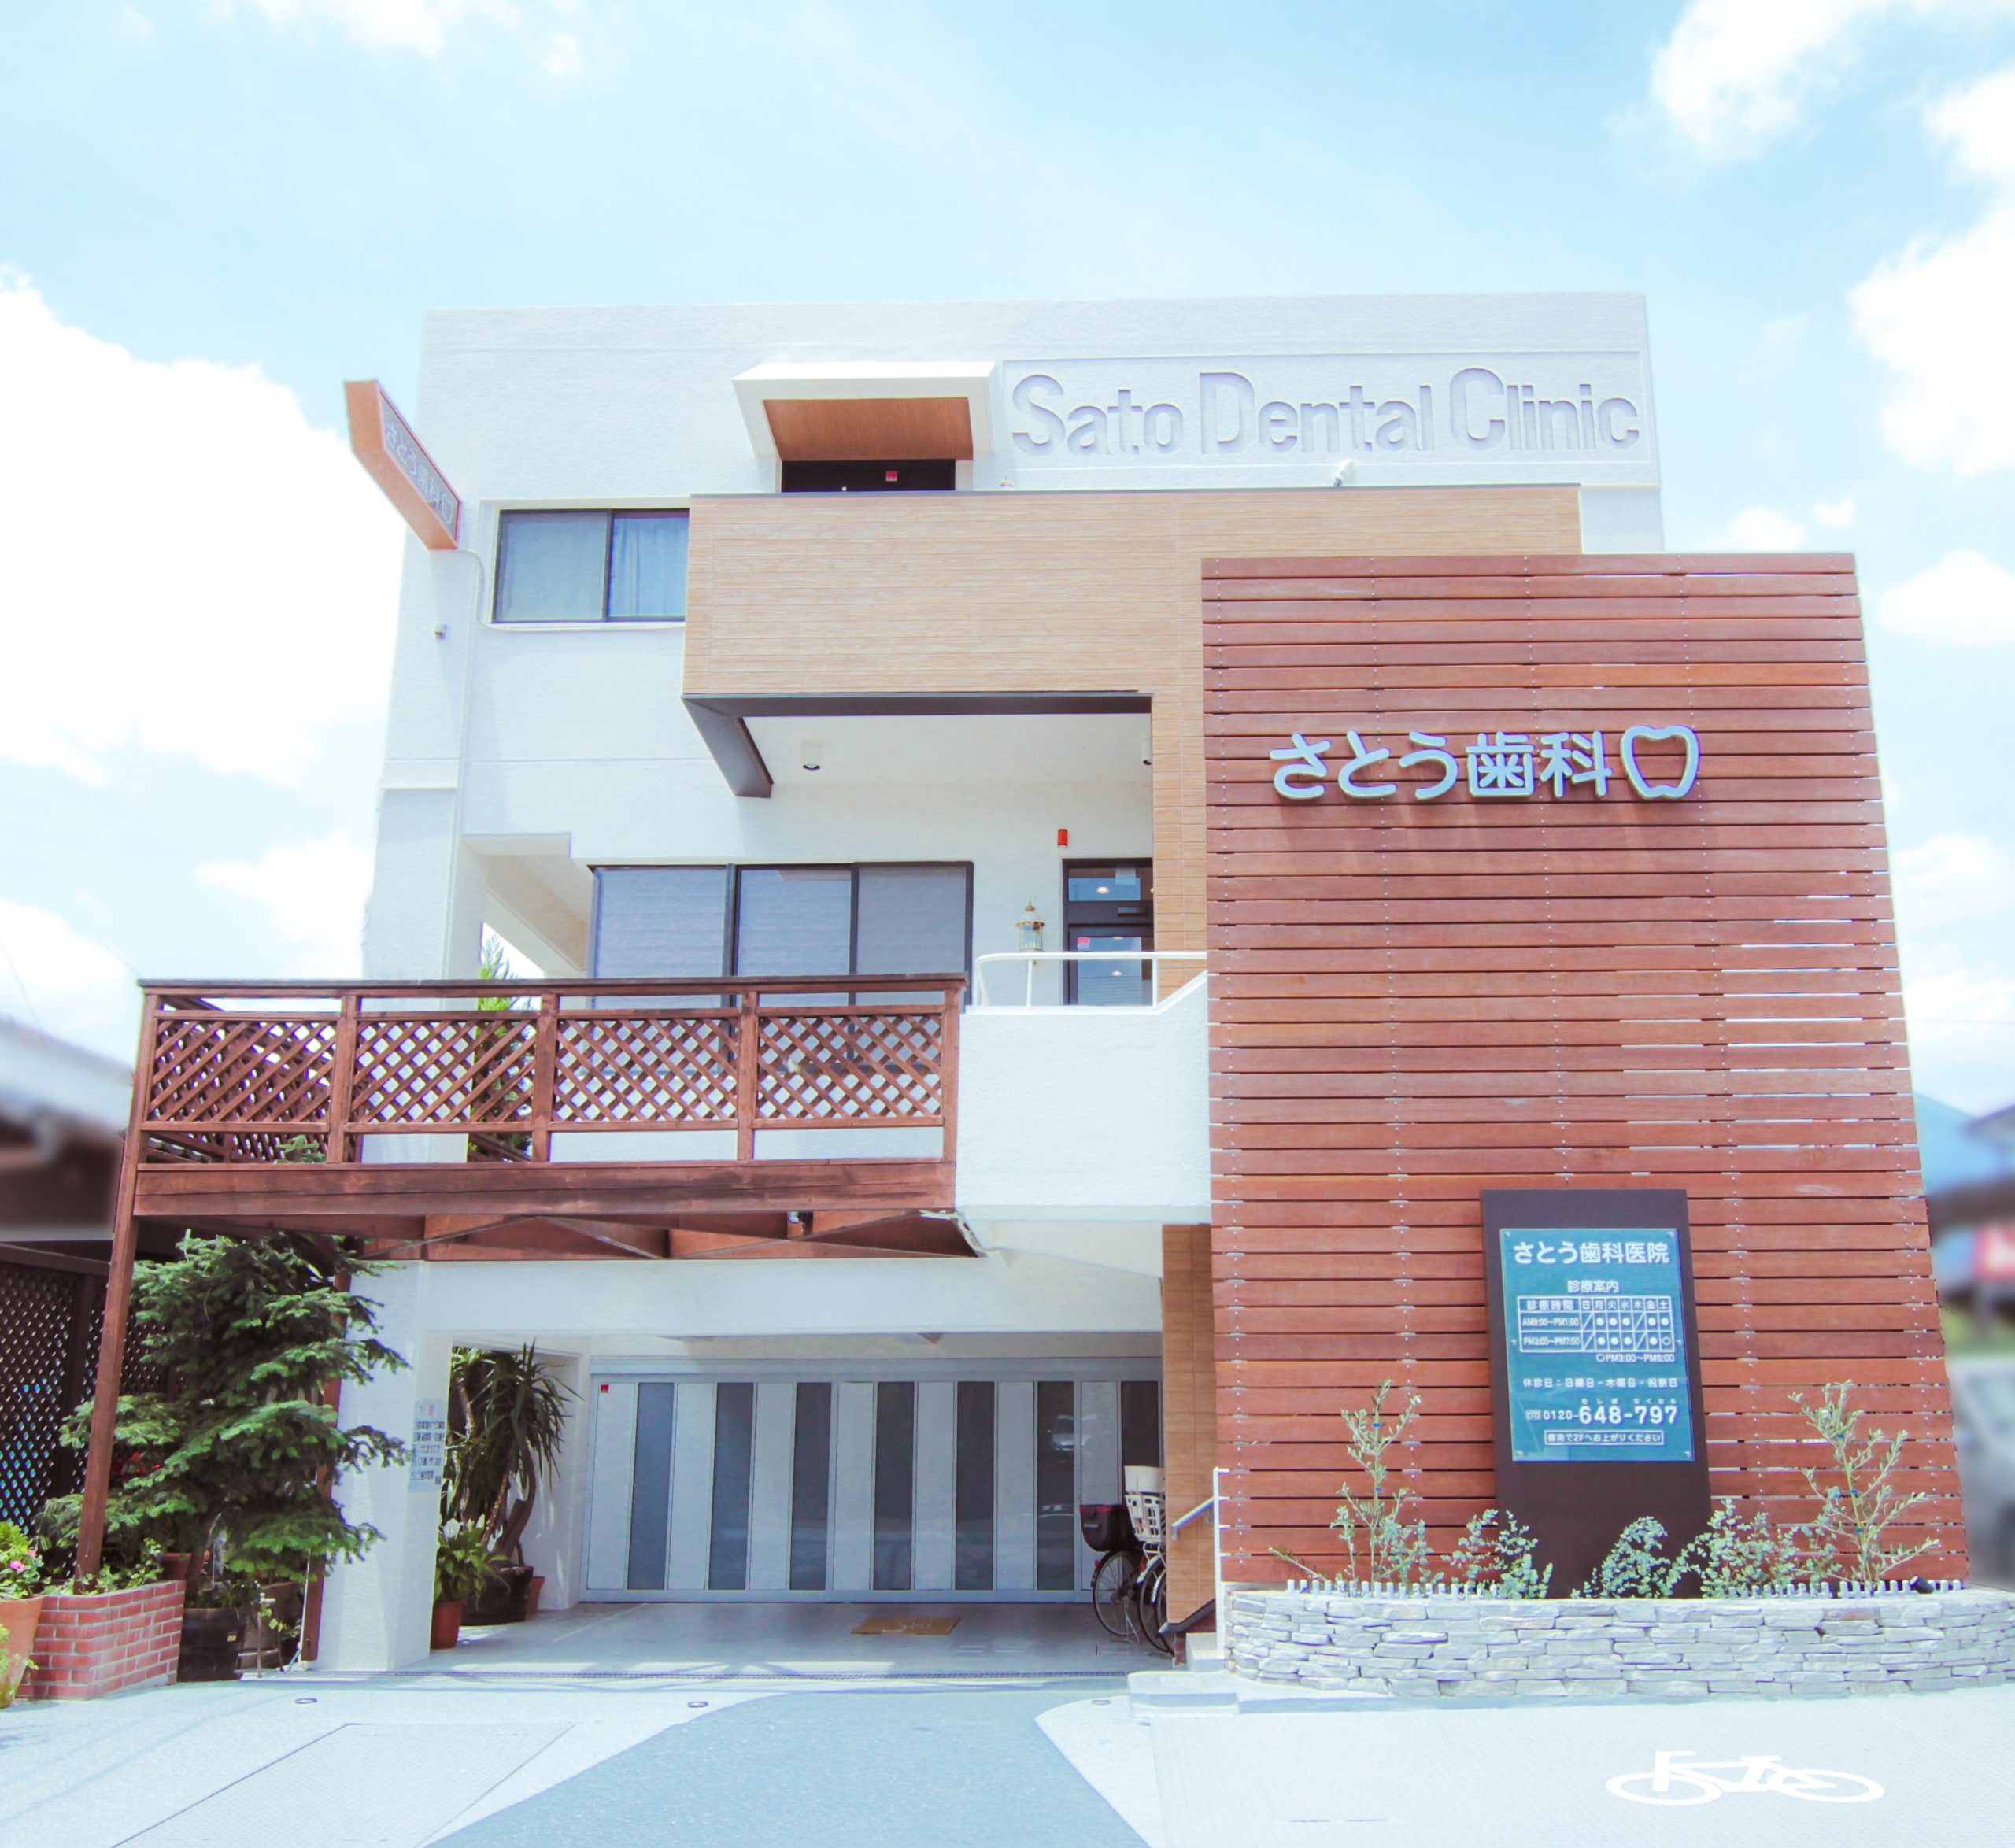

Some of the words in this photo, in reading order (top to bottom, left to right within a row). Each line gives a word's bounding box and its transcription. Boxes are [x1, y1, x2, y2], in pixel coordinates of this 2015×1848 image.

[1011, 374, 1184, 454] Sato
[1200, 371, 1436, 455] Dental
[1449, 367, 1640, 452] Clinic
[1269, 730, 1614, 800] さとう歯科
[1513, 1241, 1669, 1264] さとう歯科医院
[1567, 1280, 1619, 1293] 診療案内
[1582, 1301, 1589, 1310] 日
[1595, 1300, 1603, 1310] 月
[1608, 1300, 1617, 1310] 火
[1621, 1300, 1630, 1310] 水
[1634, 1300, 1643, 1310] 木
[1647, 1300, 1656, 1310] 金
[1659, 1300, 1669, 1310] 土
